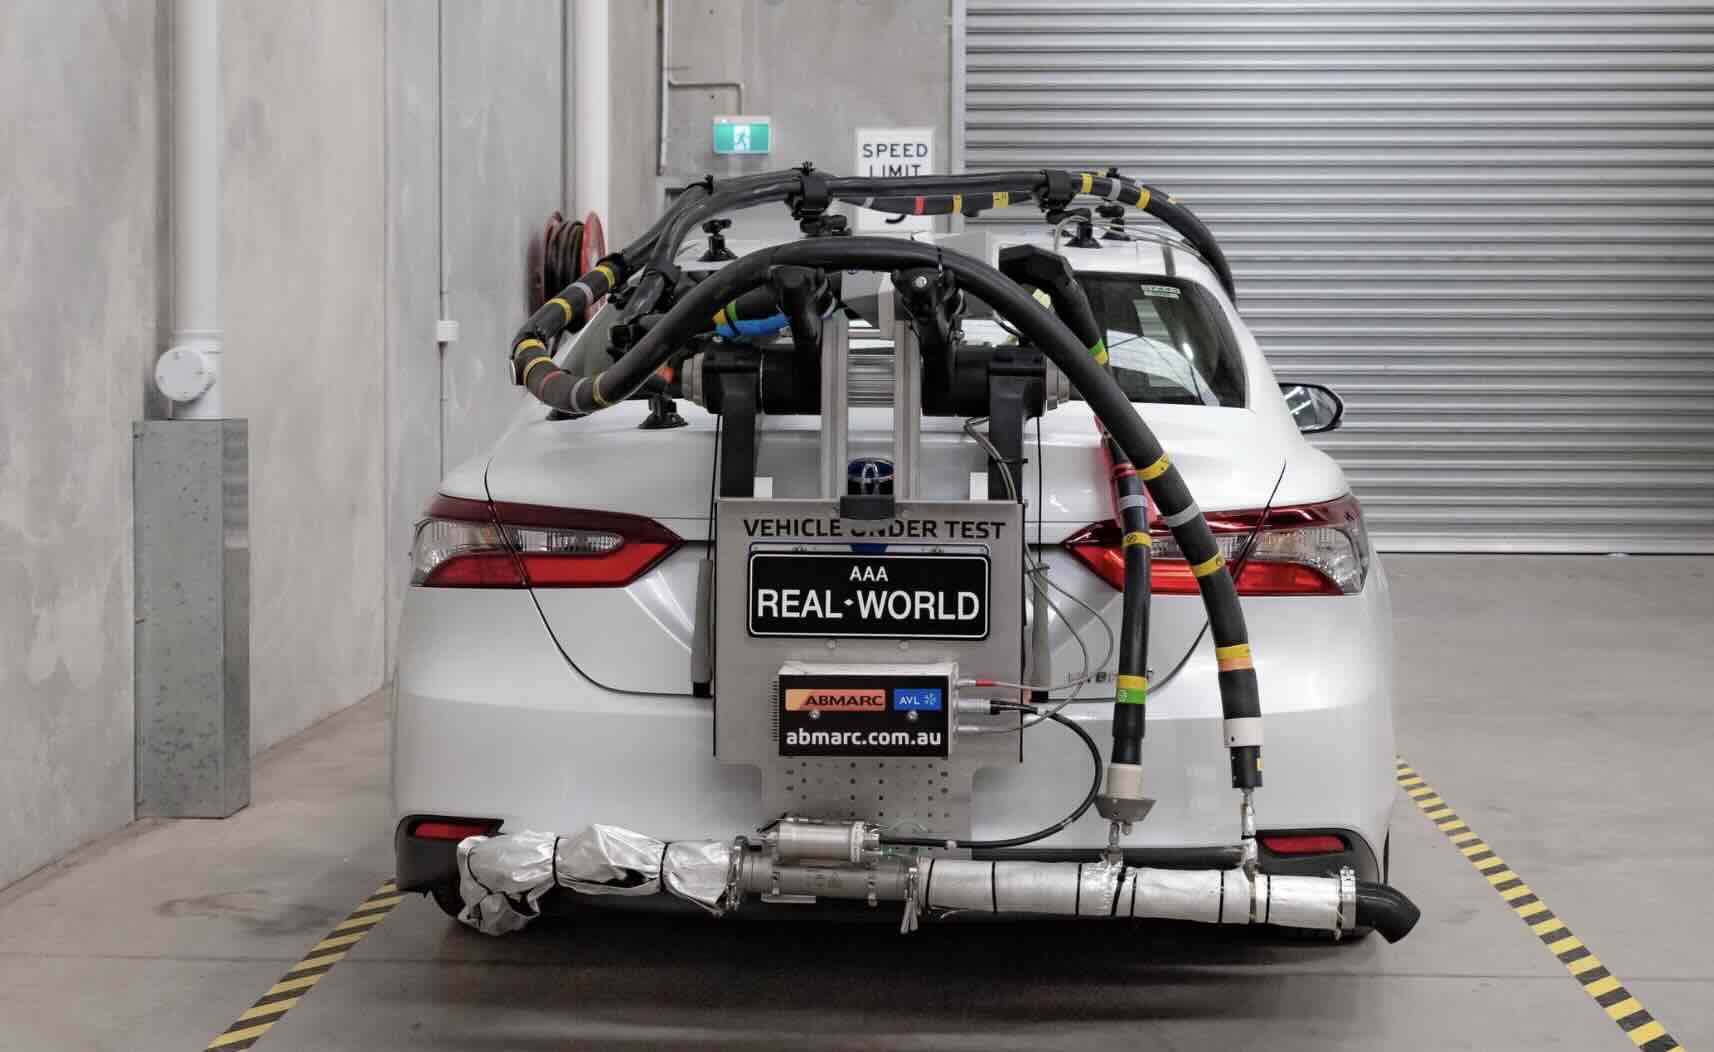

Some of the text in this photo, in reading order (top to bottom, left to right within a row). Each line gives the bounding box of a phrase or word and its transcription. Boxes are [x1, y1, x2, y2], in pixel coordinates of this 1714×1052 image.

[863, 143, 929, 158] SPEED
[743, 519, 842, 537] VEHICLE
[944, 520, 1006, 539] TEST
[849, 565, 889, 582] AAA
[805, 695, 883, 706] ABMARC
[898, 695, 920, 705] AVL
[785, 727, 942, 746] abmarc.com.au
